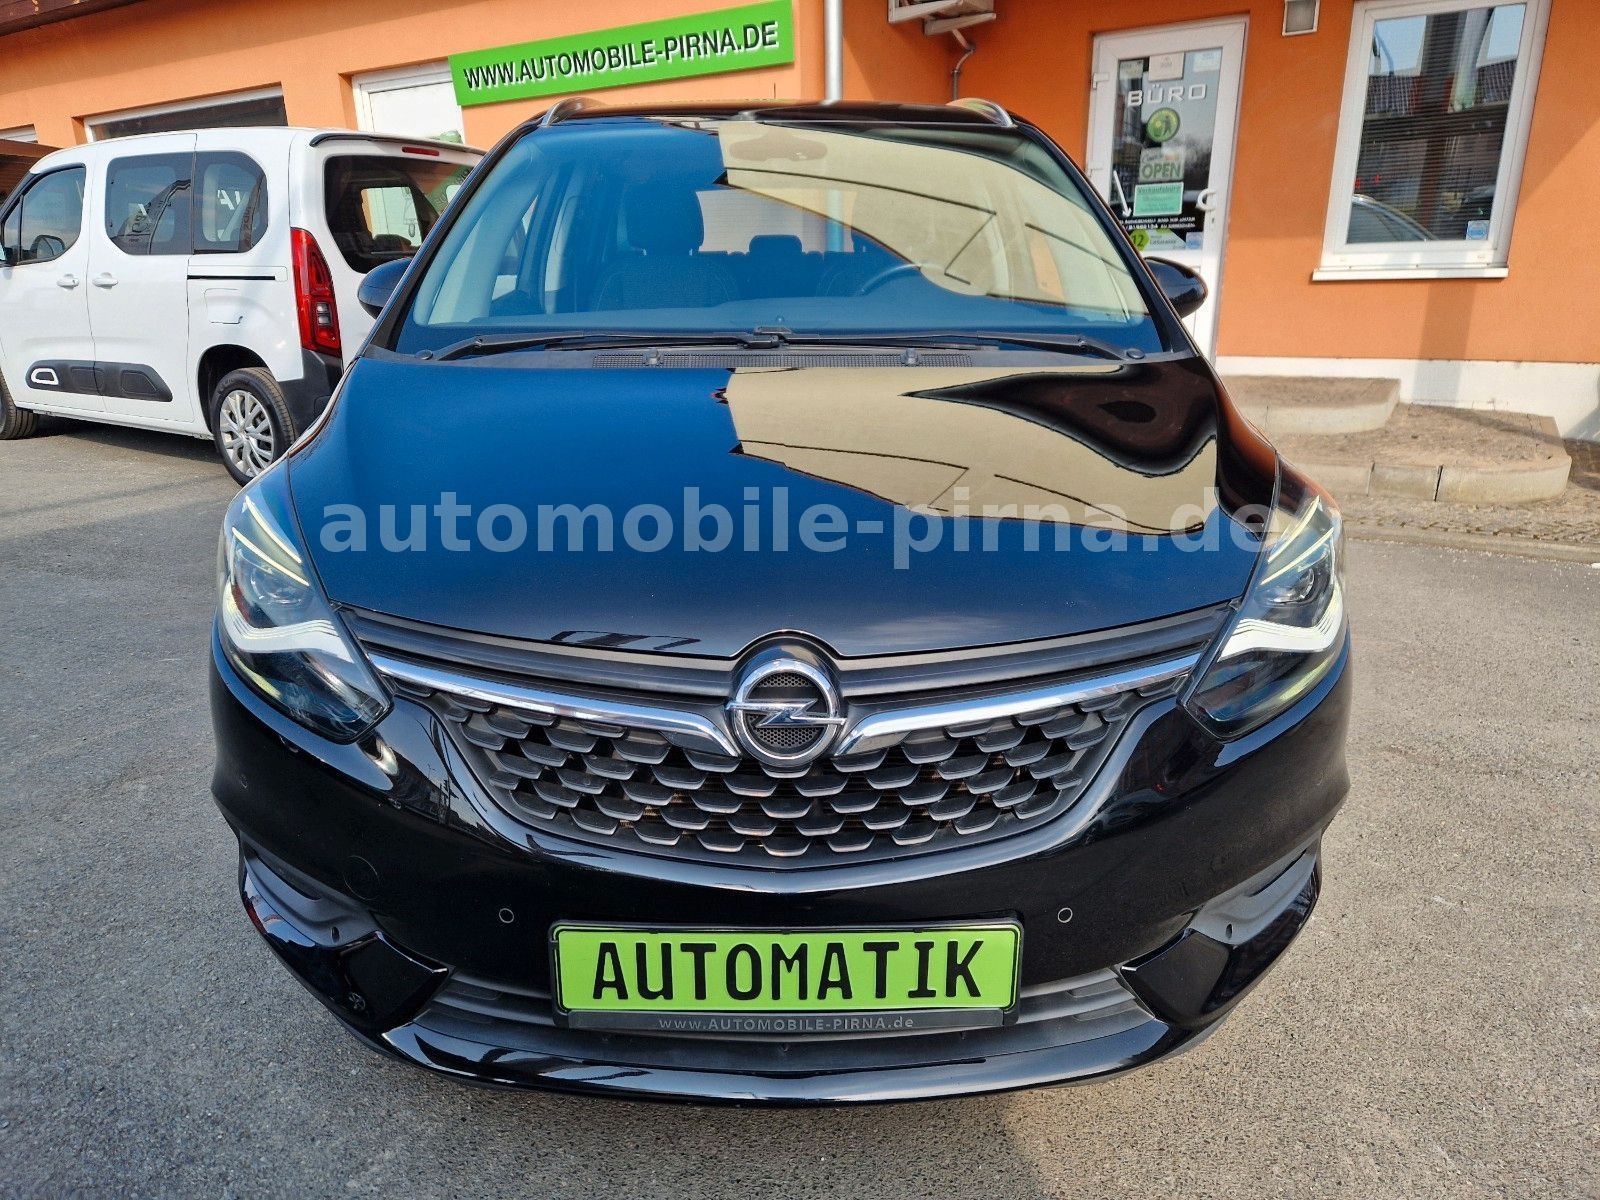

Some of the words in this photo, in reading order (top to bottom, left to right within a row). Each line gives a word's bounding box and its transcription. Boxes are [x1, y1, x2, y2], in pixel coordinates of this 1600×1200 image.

[463, 20, 778, 91] WWW.AUTOMOBILE-PIRNA.DE
[1127, 84, 1206, 107] BÜRO
[1142, 162, 1181, 180] OPEN
[592, 940, 984, 1001] AUTOMATIK
[658, 1015, 915, 1032] www.AUTOMOBILE-PIRNA.de
